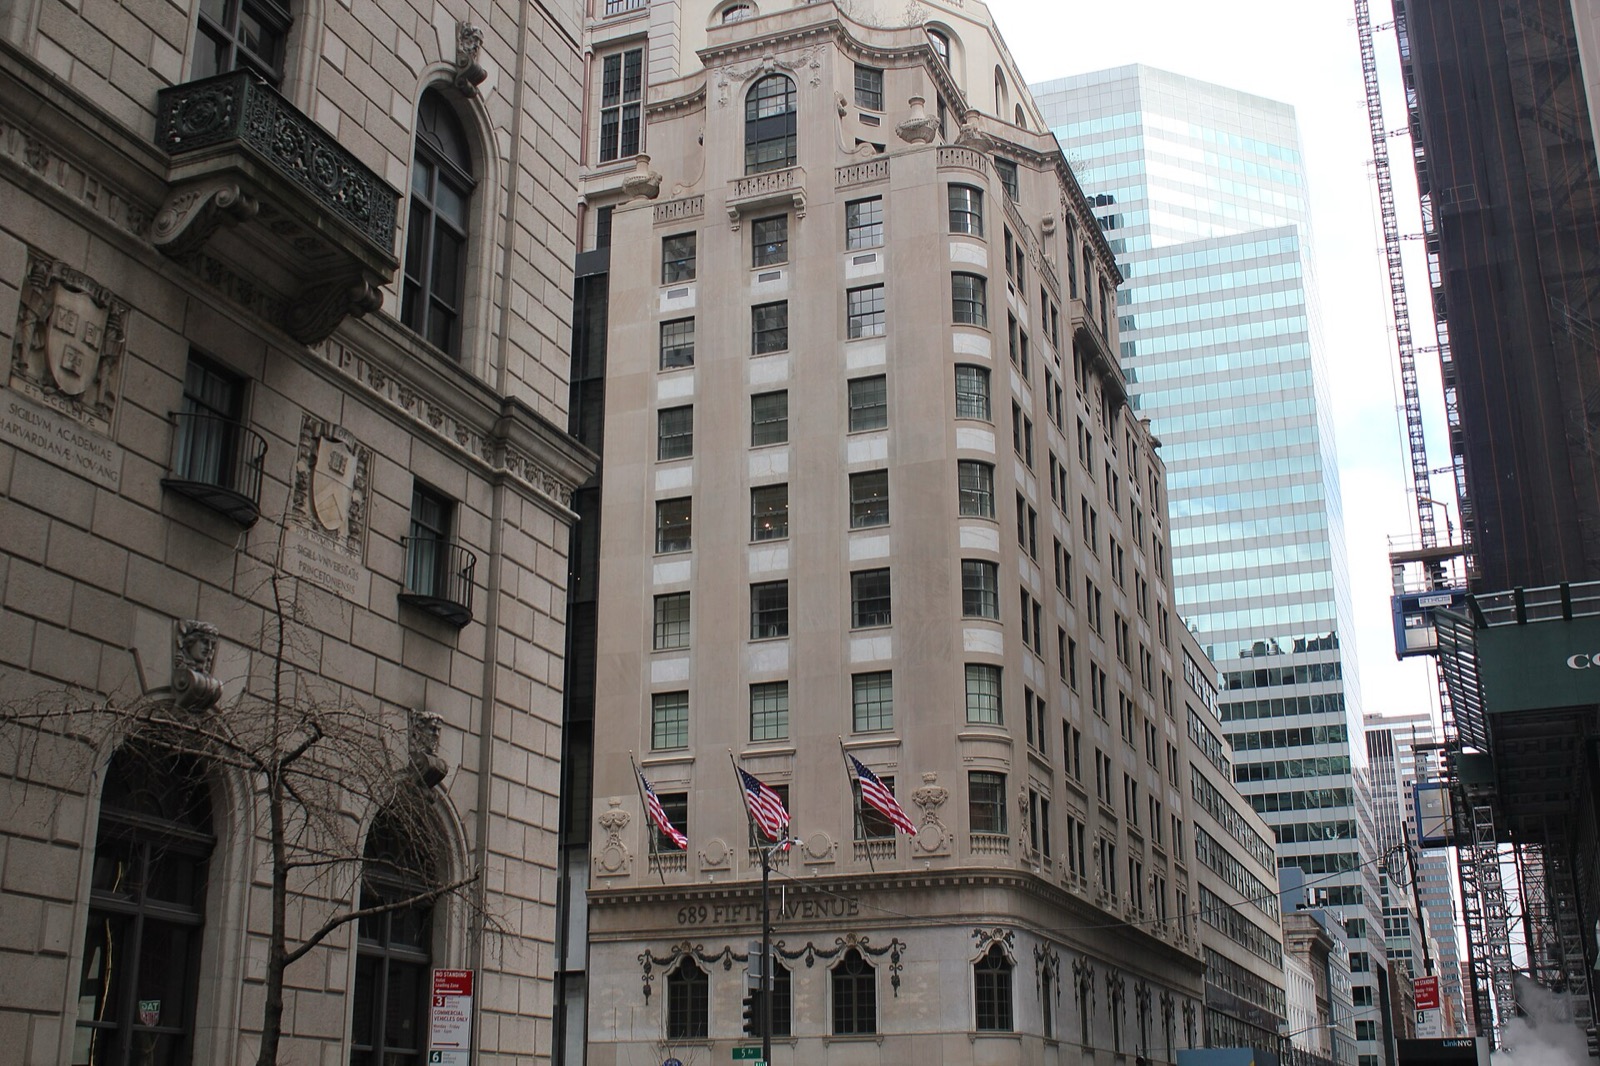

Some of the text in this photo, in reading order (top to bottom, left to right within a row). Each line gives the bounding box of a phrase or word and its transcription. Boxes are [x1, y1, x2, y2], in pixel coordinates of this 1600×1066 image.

[677, 906, 708, 924] 689
[776, 897, 860, 920] AVENUE
[436, 996, 443, 1007] 3
[1418, 1012, 1423, 1022] 6
[433, 1052, 439, 1062] 6
[741, 1049, 746, 1058] 5
